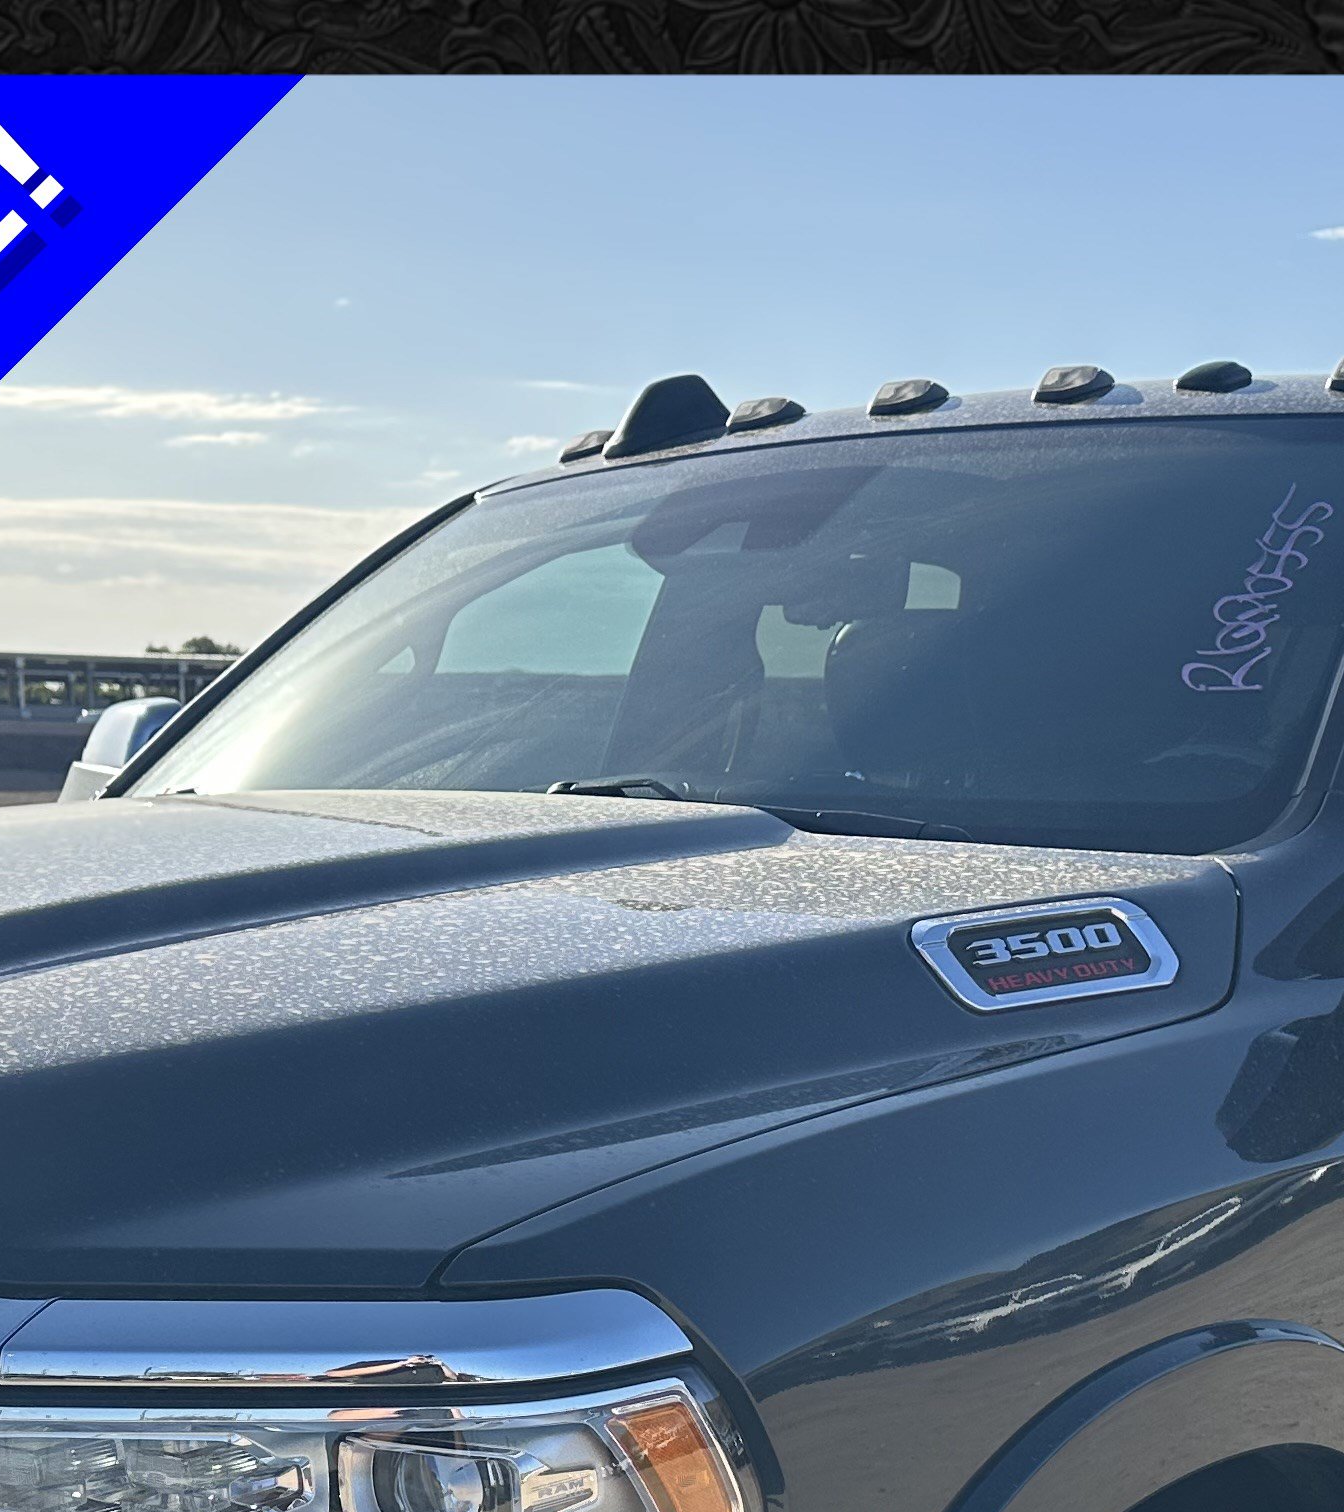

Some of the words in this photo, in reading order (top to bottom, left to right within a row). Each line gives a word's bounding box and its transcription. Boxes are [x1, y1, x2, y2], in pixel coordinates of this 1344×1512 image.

[965, 922, 1122, 966] 3500
[988, 967, 1069, 991] HEAVY
[1072, 957, 1136, 979] DUTY
[537, 1478, 584, 1499] RAM
